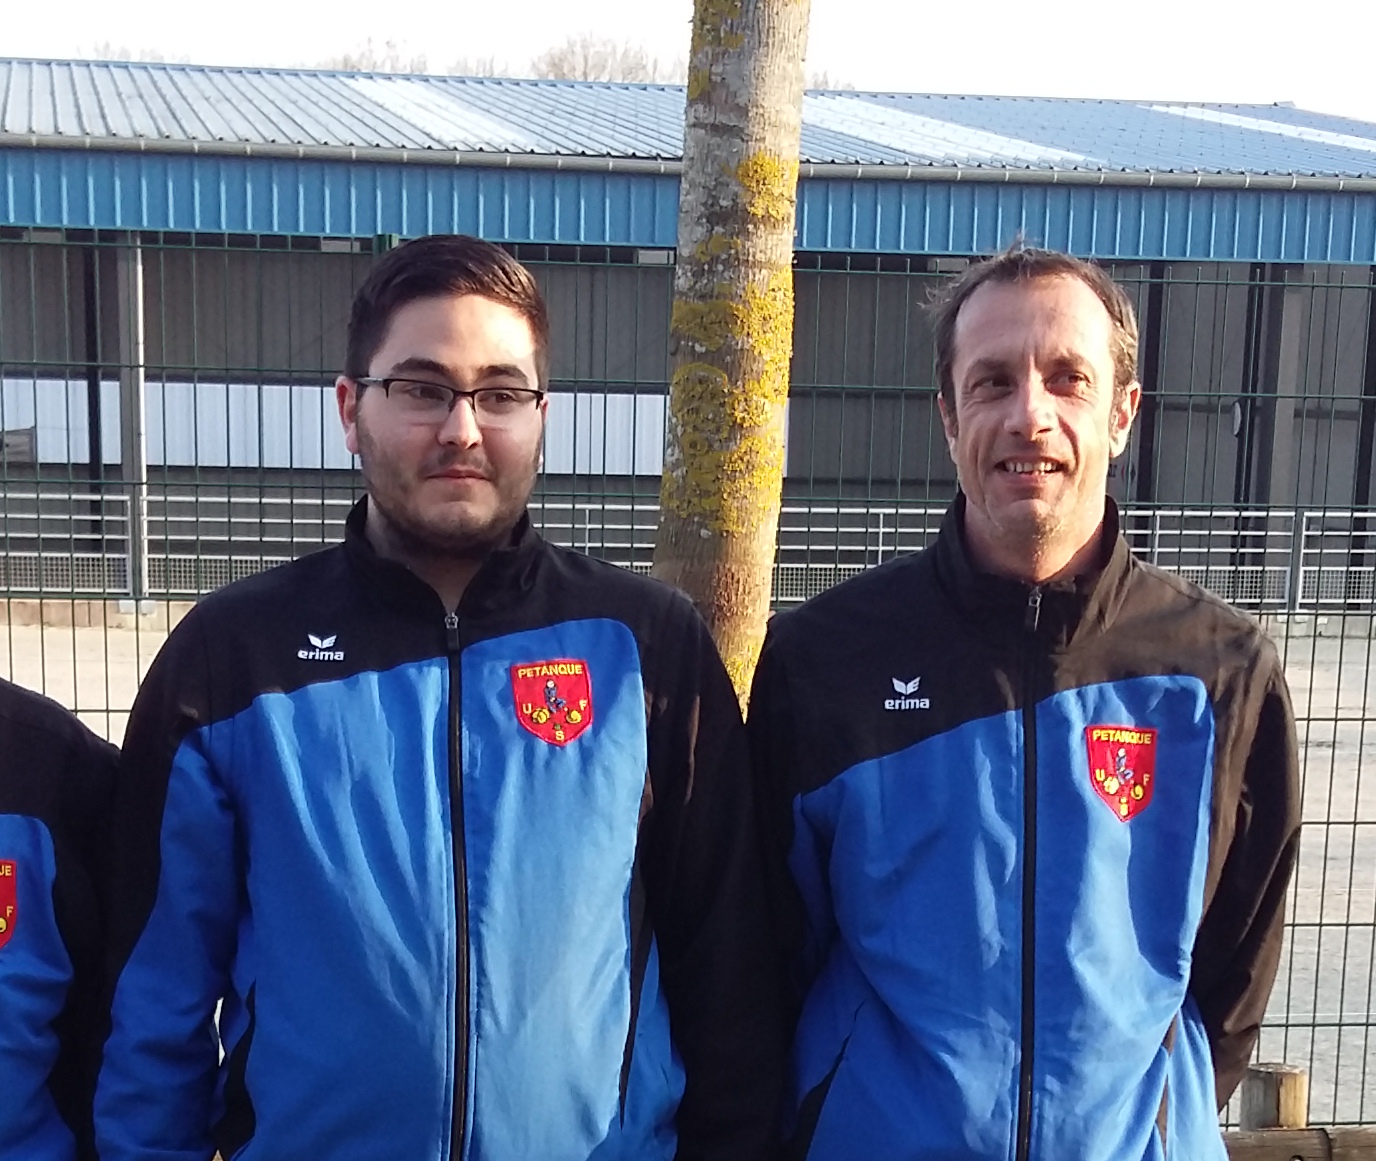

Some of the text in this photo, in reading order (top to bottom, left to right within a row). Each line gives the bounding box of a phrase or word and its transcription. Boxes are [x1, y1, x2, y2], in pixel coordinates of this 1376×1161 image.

[297, 648, 345, 661] erima
[517, 663, 583, 679] PETANQUE
[523, 700, 587, 714] U F
[884, 696, 930, 711] erima
[555, 729, 564, 741] S
[1092, 729, 1153, 744] PETANQUE
[1096, 769, 1150, 785] U F
[7, 906, 13, 917] F
